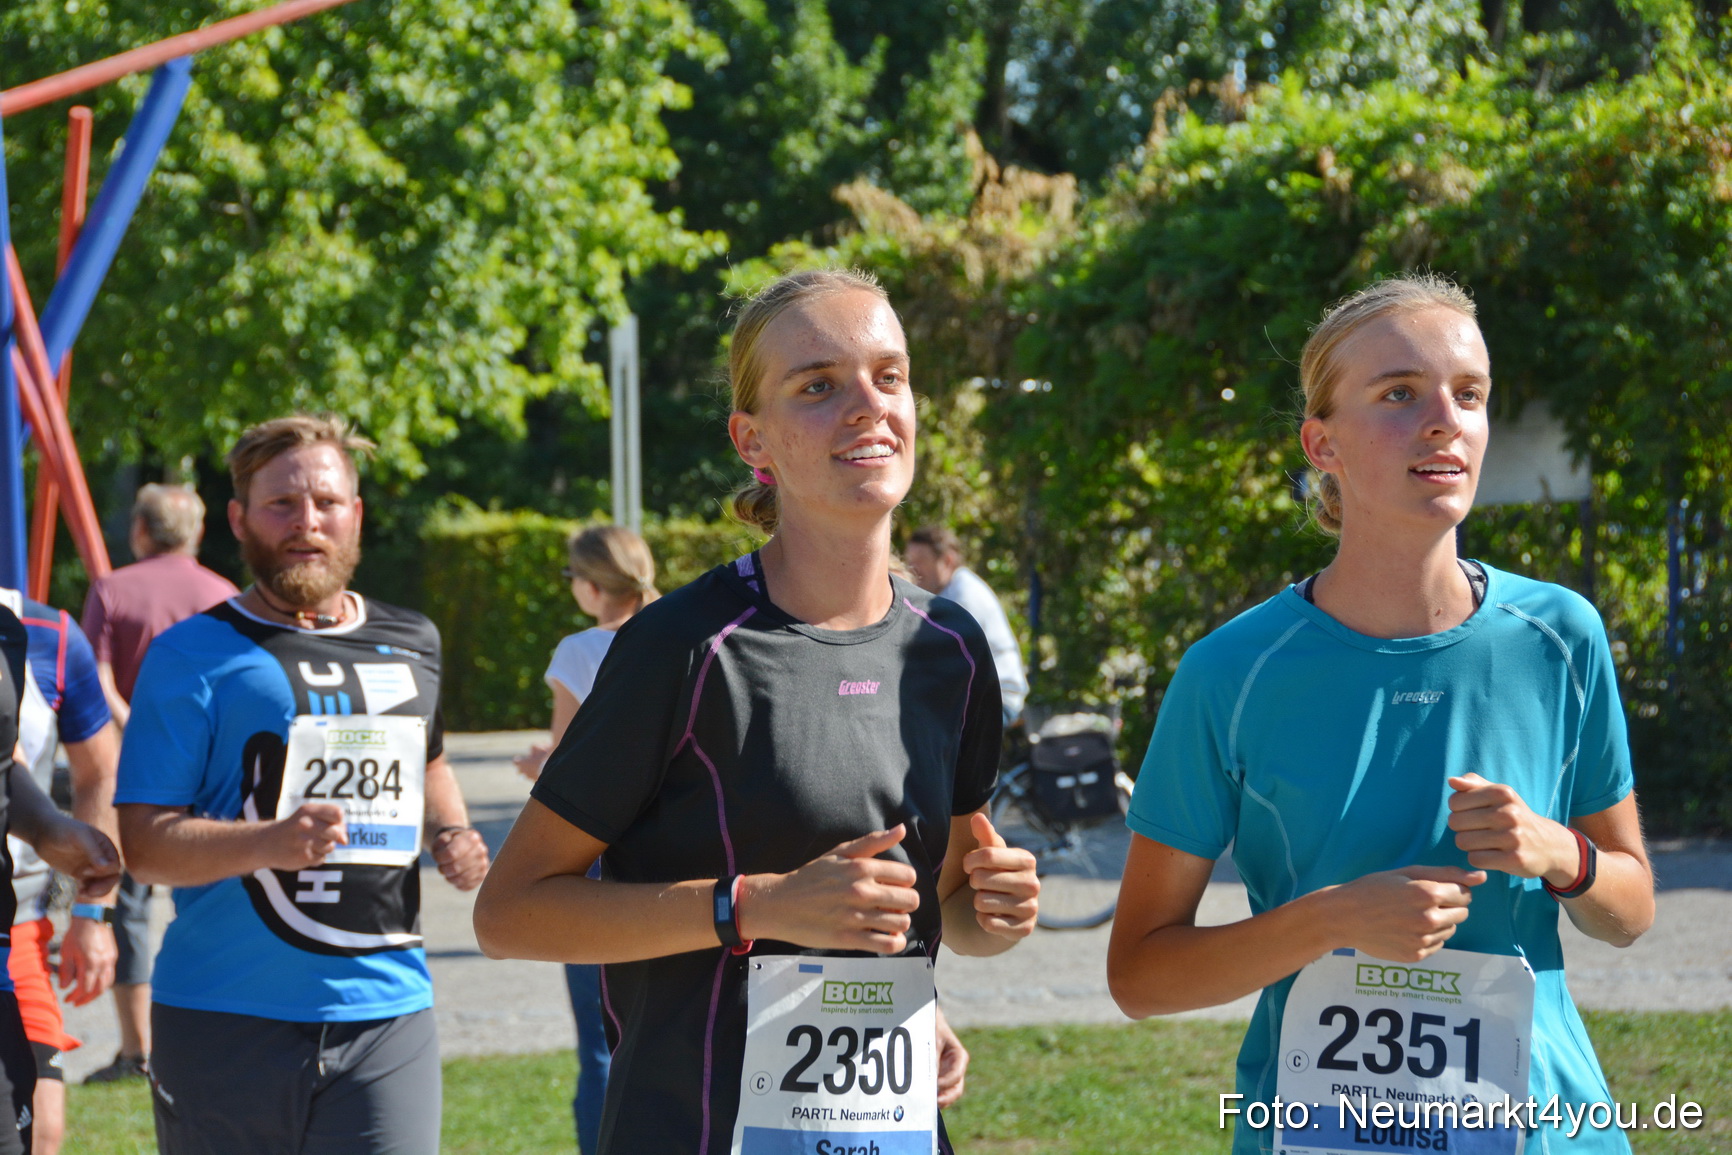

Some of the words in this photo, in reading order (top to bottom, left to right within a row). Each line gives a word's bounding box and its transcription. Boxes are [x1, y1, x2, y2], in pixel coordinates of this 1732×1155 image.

[327, 730, 386, 745] BOCK
[303, 758, 403, 801] 2284
[1356, 963, 1461, 996] BOCK
[822, 980, 894, 1005] BOCK
[1355, 987, 1388, 996] inspired
[1389, 989, 1400, 999] by
[1401, 991, 1425, 1000] smart
[1426, 995, 1462, 1005] concepts
[820, 1006, 849, 1014] inspired
[849, 1007, 857, 1015] by
[872, 1007, 894, 1015] concepts
[1316, 1005, 1481, 1083] 2351
[779, 1025, 912, 1095] 2350
[1293, 1056, 1302, 1068] C
[756, 1077, 765, 1090] C
[1331, 1083, 1382, 1099] PARTL
[1386, 1087, 1456, 1104] Neumarkt
[791, 1106, 837, 1121] PARTL
[840, 1108, 890, 1121] Neumarkt
[1354, 1119, 1449, 1151] Louisa
